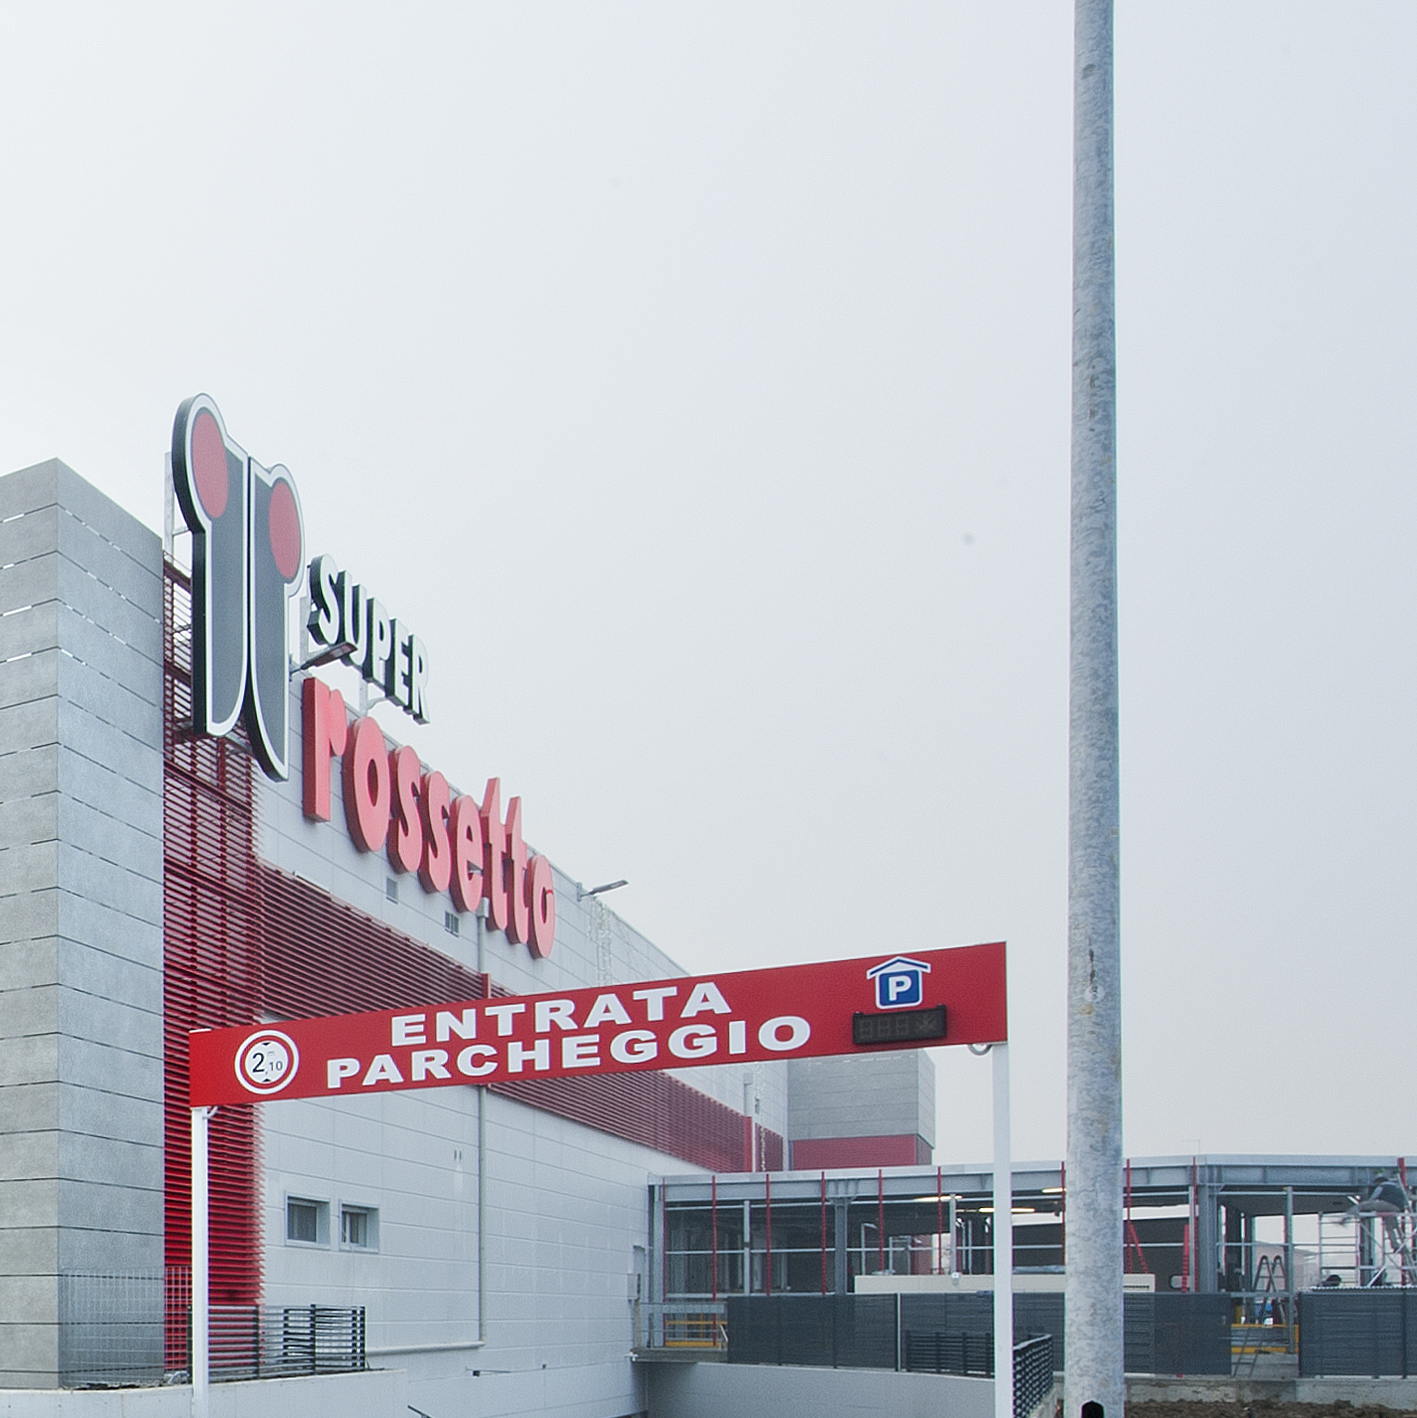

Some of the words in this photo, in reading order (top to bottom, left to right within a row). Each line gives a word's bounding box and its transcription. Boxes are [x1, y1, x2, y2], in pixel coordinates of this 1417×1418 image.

[308, 553, 430, 724] SUPER
[303, 677, 555, 959] rossetto
[391, 981, 732, 1047] ENTRATA
[888, 975, 912, 1002] P
[327, 1016, 811, 1089] PARCHEGGIO
